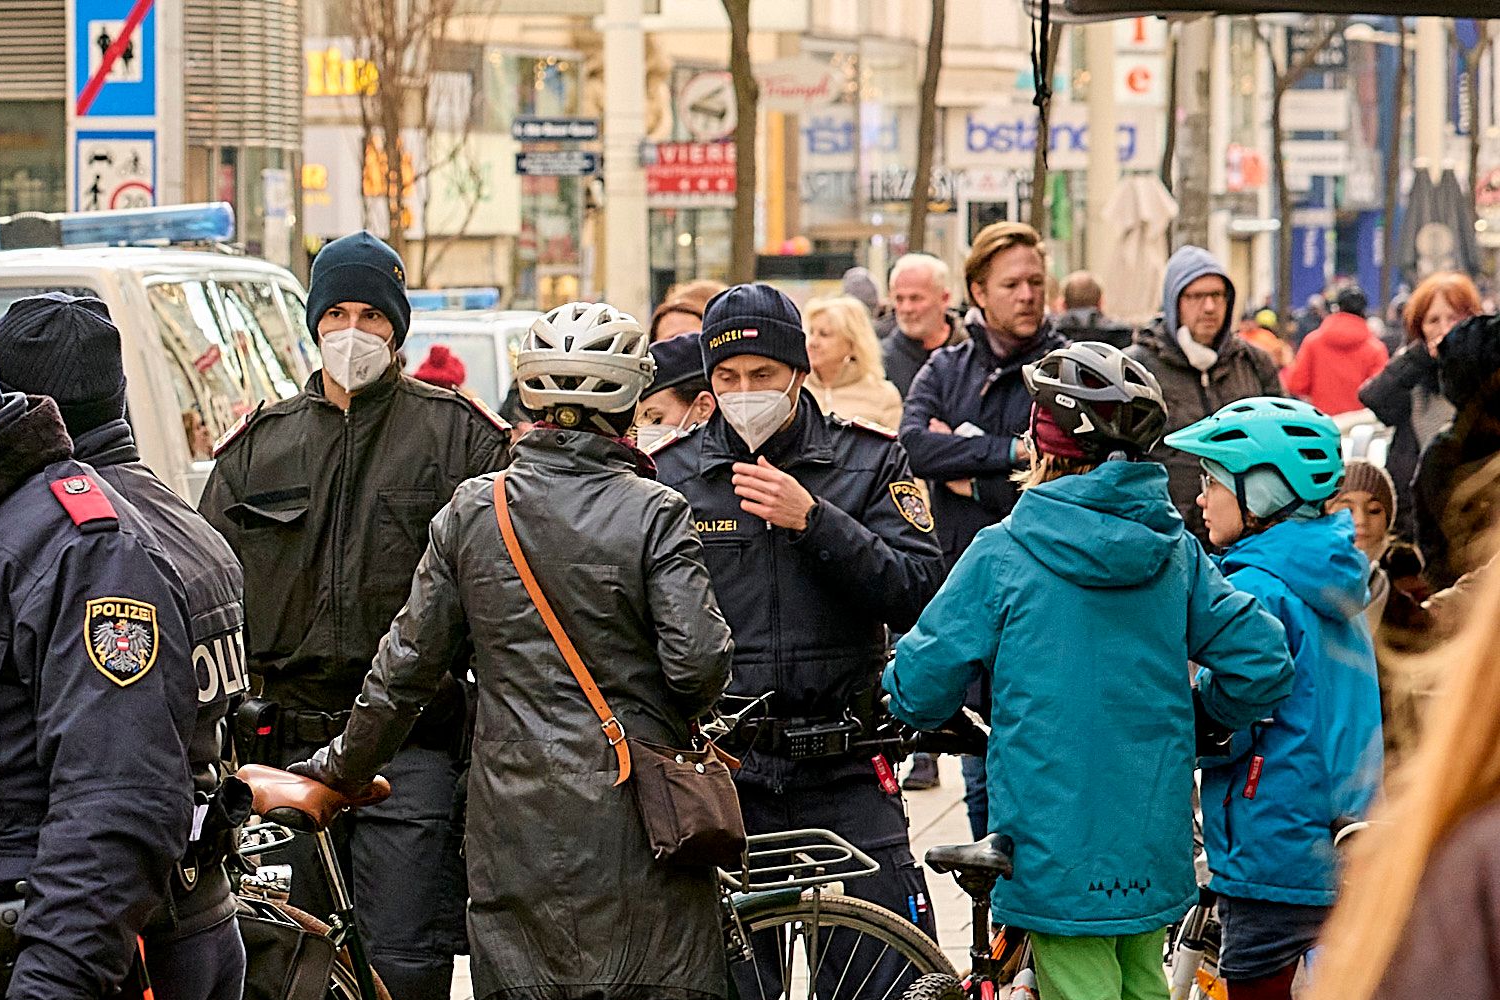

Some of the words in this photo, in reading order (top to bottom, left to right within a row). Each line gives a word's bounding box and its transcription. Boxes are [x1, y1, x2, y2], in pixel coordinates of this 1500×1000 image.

[709, 329, 742, 350] POLIZEI
[695, 520, 737, 532] OLIZEI
[92, 603, 152, 622] POLIZEI
